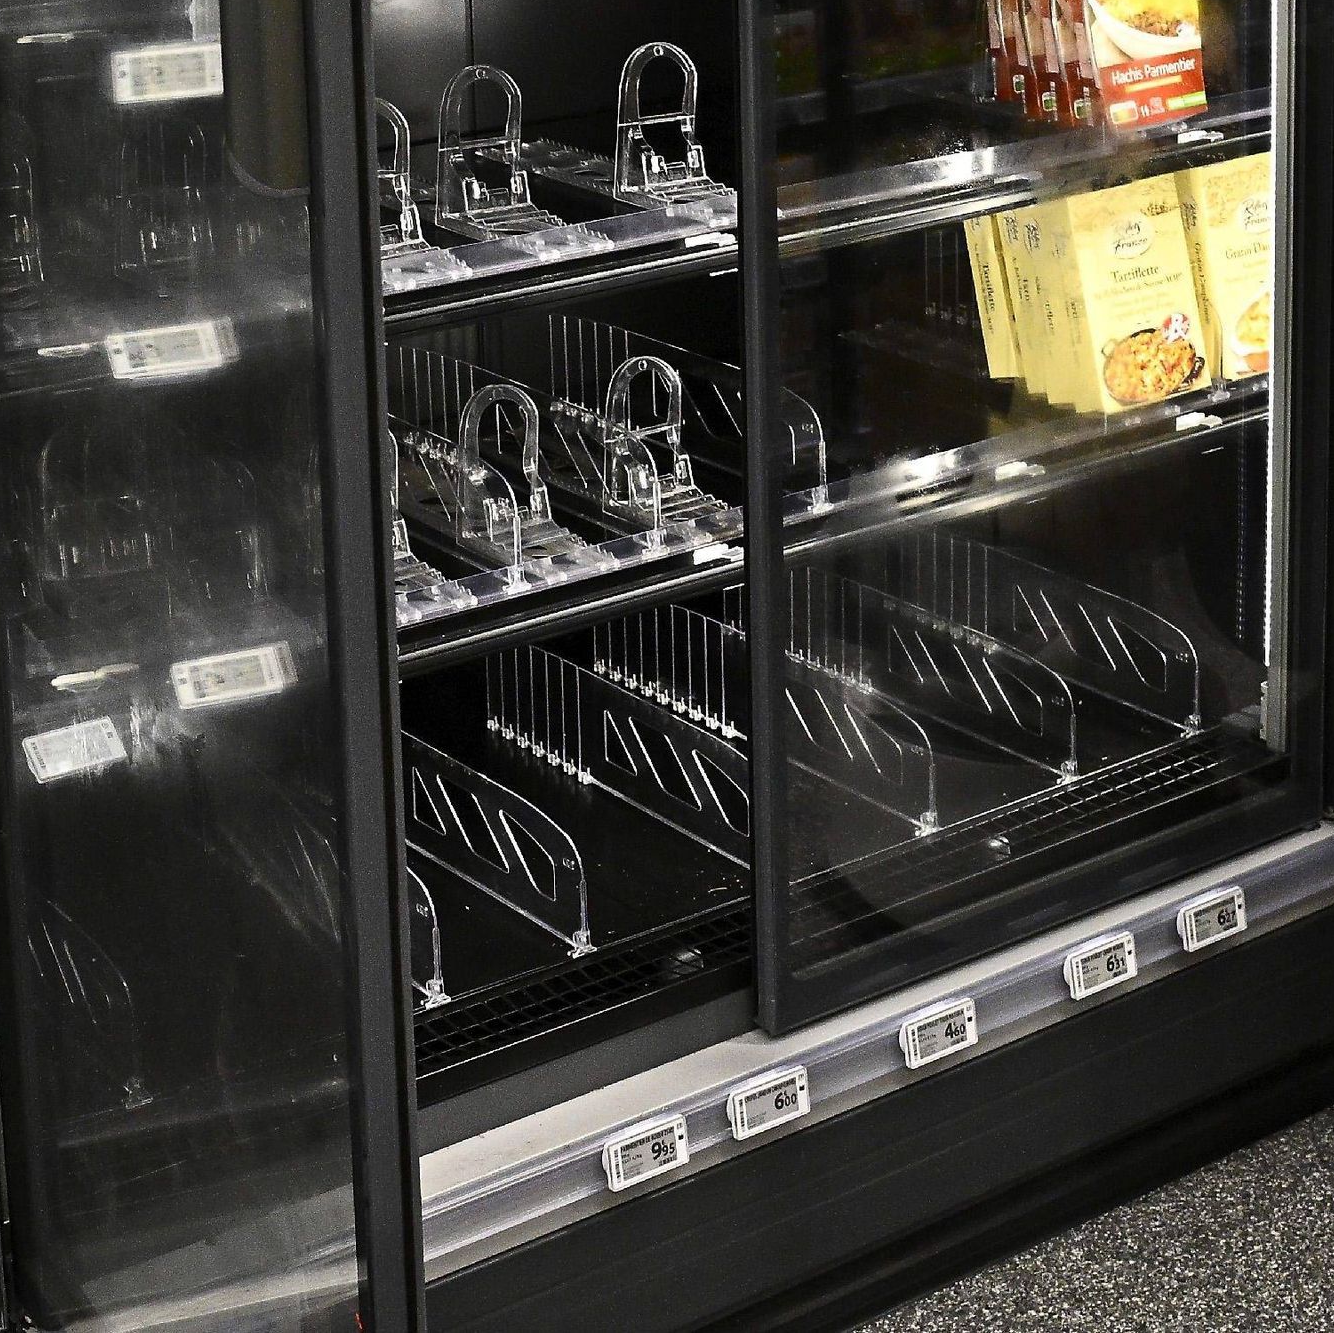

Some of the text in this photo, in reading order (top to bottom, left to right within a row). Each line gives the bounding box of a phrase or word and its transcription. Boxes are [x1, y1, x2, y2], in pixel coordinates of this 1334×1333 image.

[1111, 56, 1196, 86] Hachis Parmentier
[1110, 265, 1159, 283] Tartiflette
[774, 1091, 797, 1110] 6€00
[651, 1139, 675, 1160] 9€95
